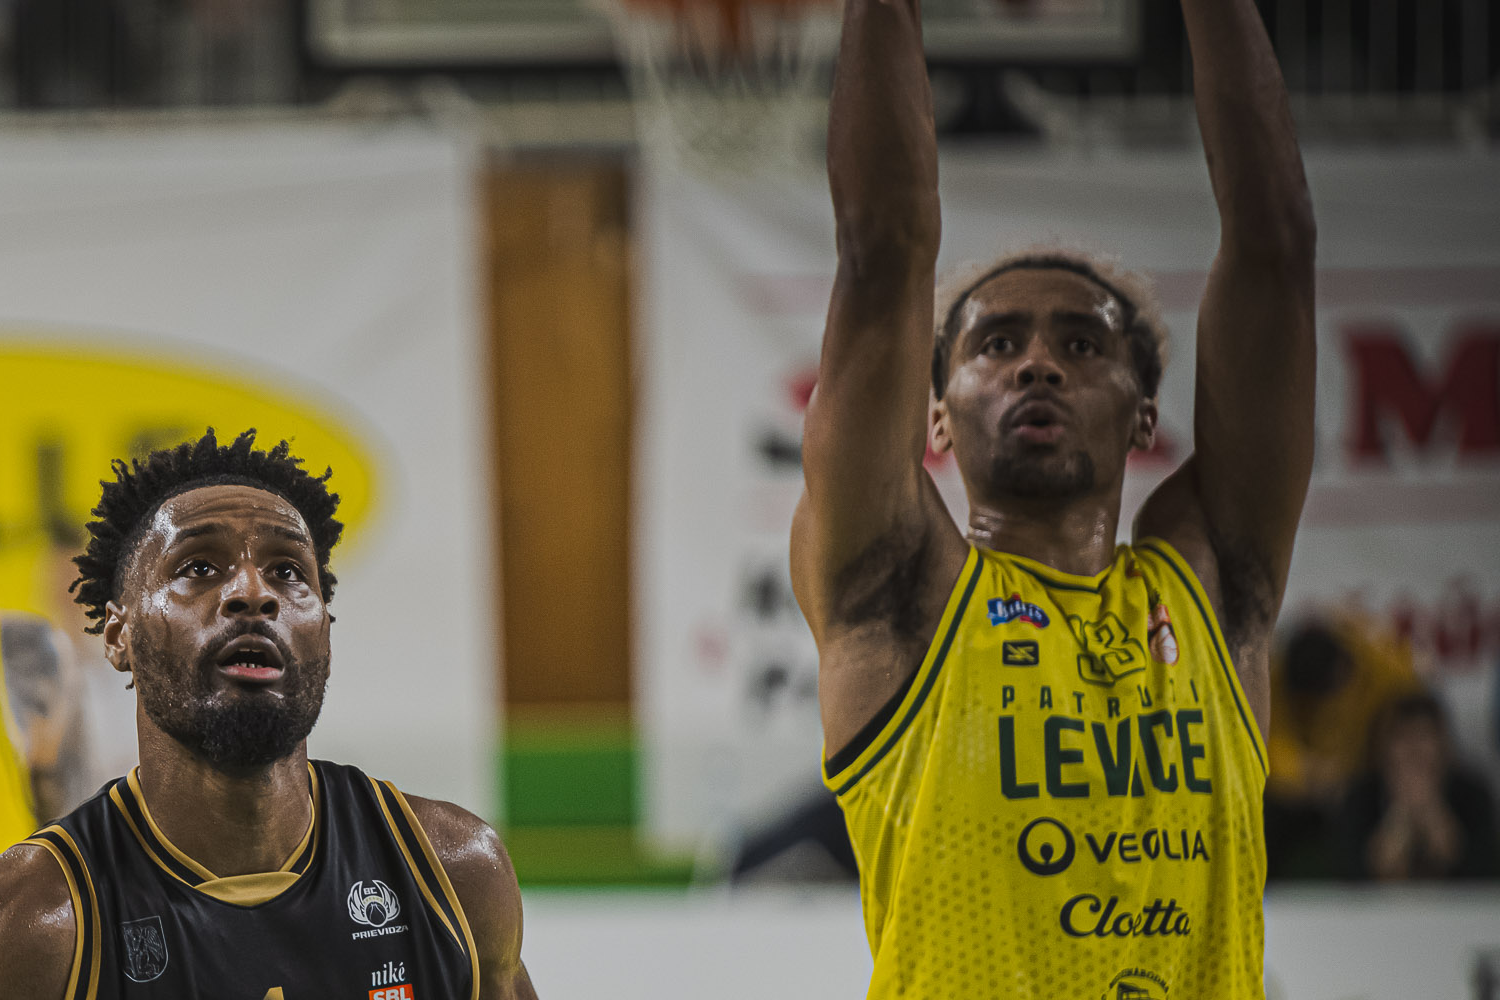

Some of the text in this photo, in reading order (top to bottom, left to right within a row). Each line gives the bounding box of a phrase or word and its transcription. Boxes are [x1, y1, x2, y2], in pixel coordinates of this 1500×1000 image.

[1084, 828, 1211, 865] VEOLIA
[363, 886, 378, 895] BC
[351, 924, 409, 940] PRIEVIDZA
[371, 961, 406, 987] niké
